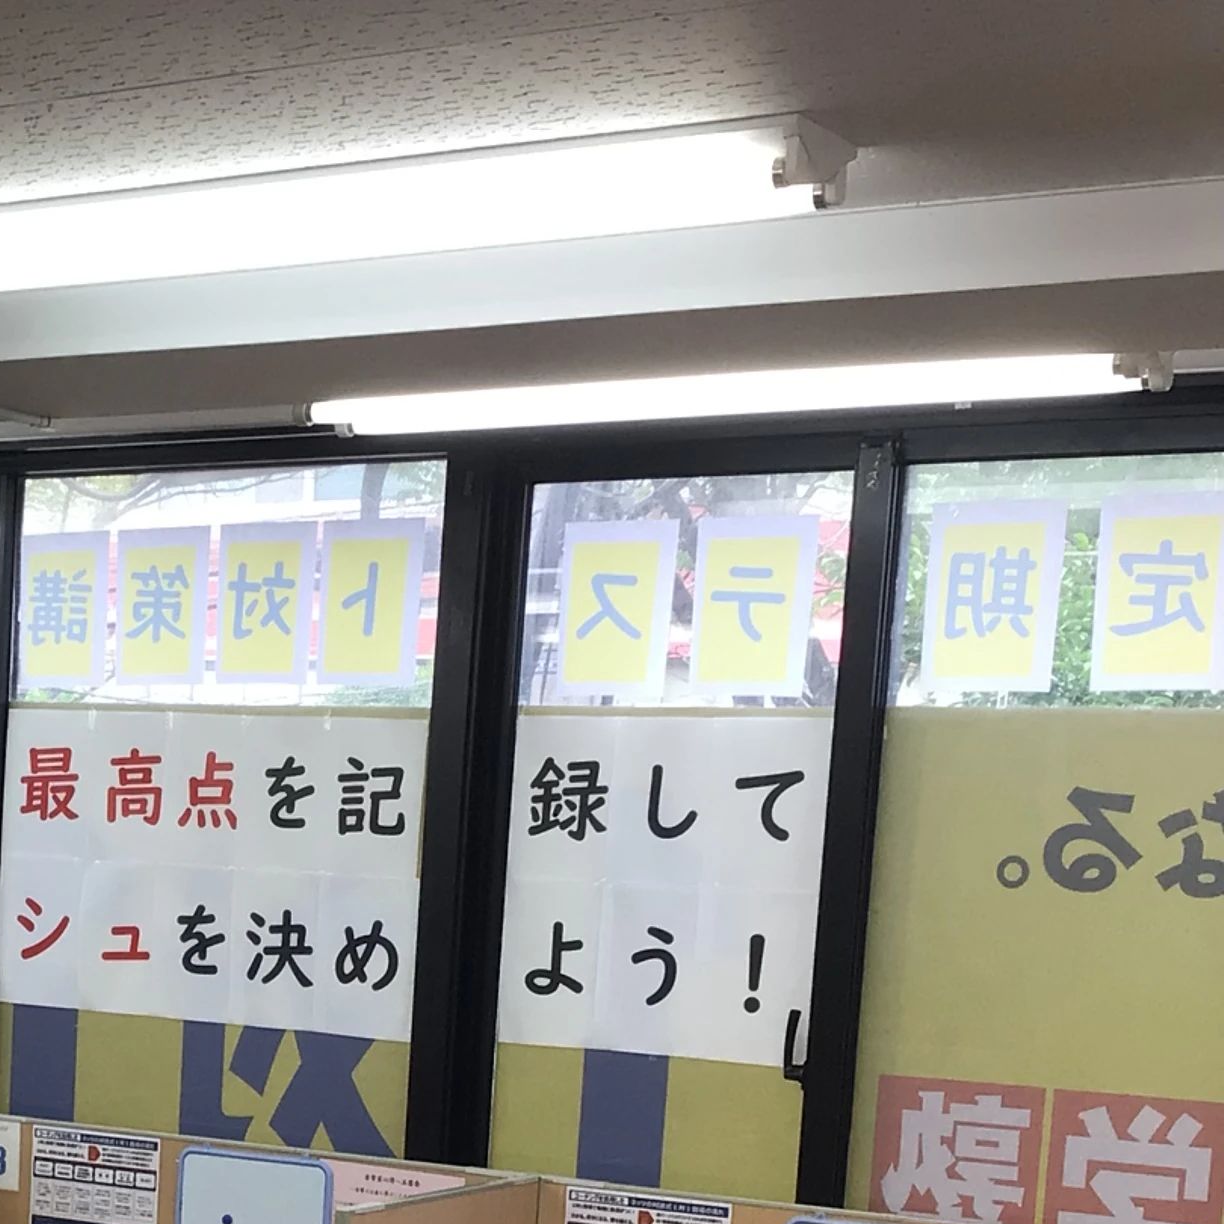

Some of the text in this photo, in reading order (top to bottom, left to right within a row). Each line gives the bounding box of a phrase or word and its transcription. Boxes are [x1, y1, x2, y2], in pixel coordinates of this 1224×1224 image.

[19, 747, 407, 837] 最高点を記
[527, 756, 806, 843] 録して
[15, 896, 400, 992] シュを決め
